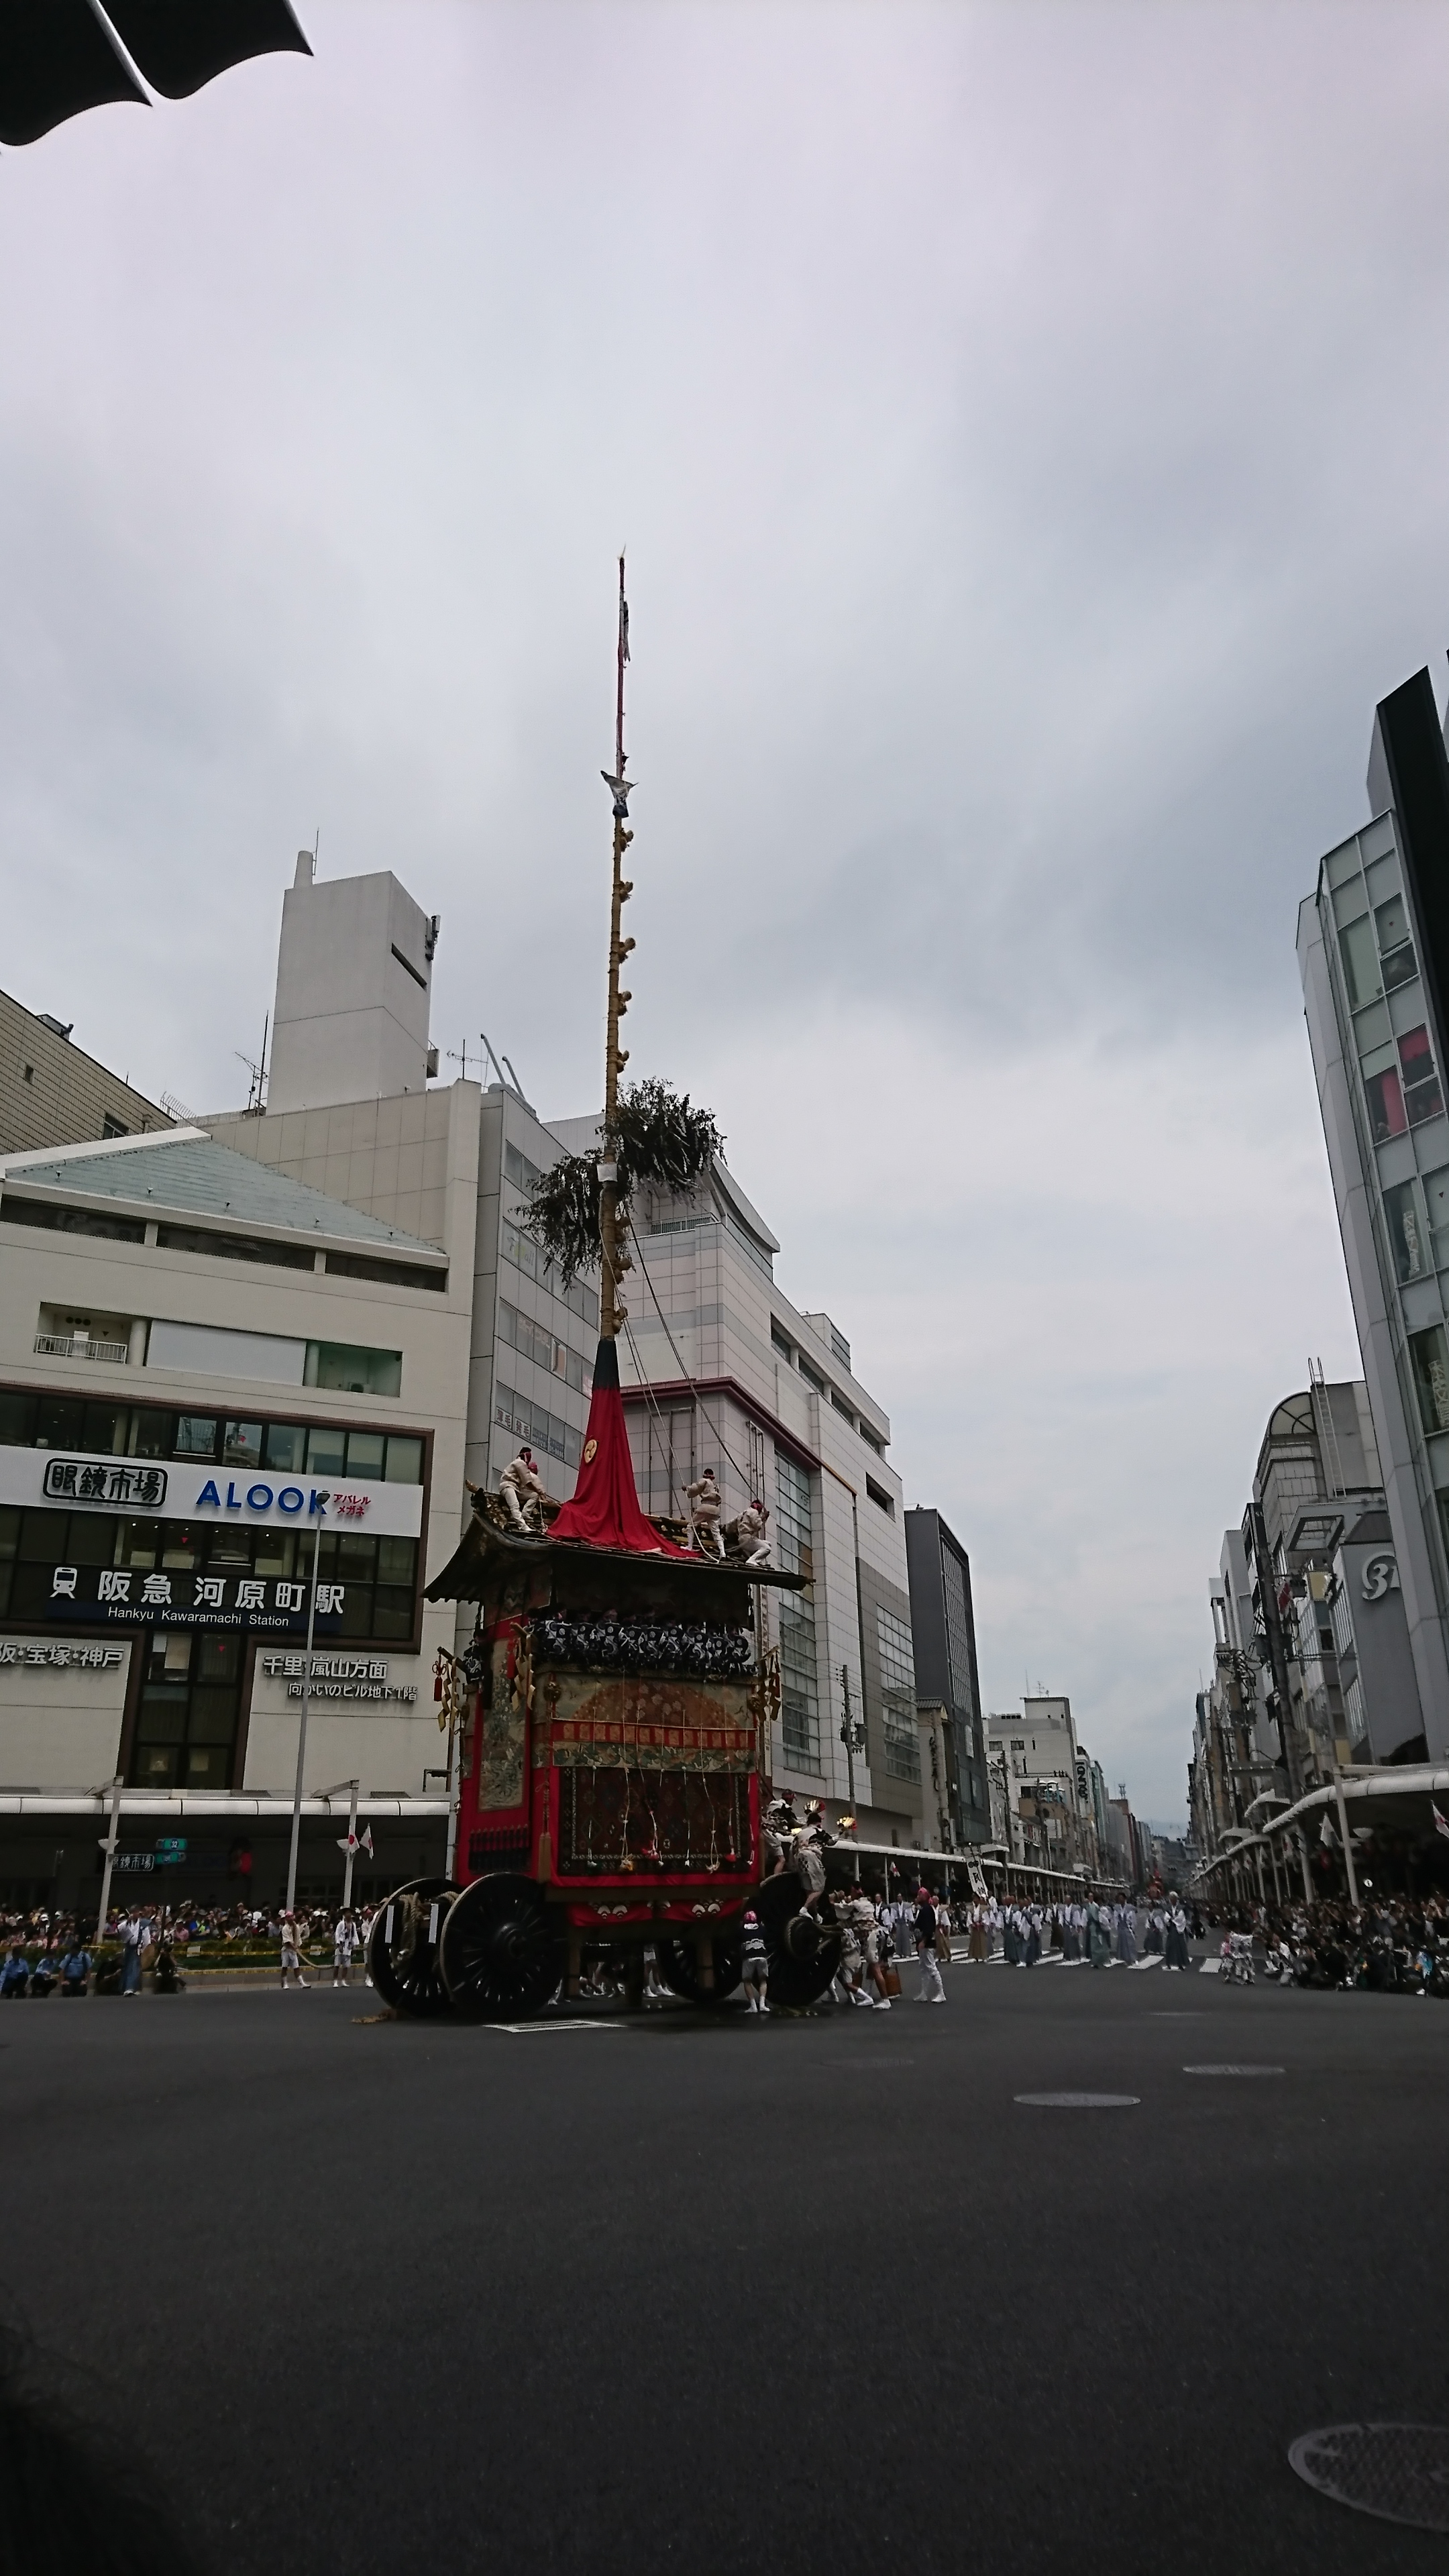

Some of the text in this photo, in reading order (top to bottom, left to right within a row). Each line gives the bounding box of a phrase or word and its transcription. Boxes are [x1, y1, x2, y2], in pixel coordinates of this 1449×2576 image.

[52, 1464, 160, 1502] 眼鏡市場
[195, 1480, 327, 1515] ALOOK
[337, 1505, 365, 1516] メガネ
[108, 1606, 289, 1627] Hankyu Kawaramachi Station
